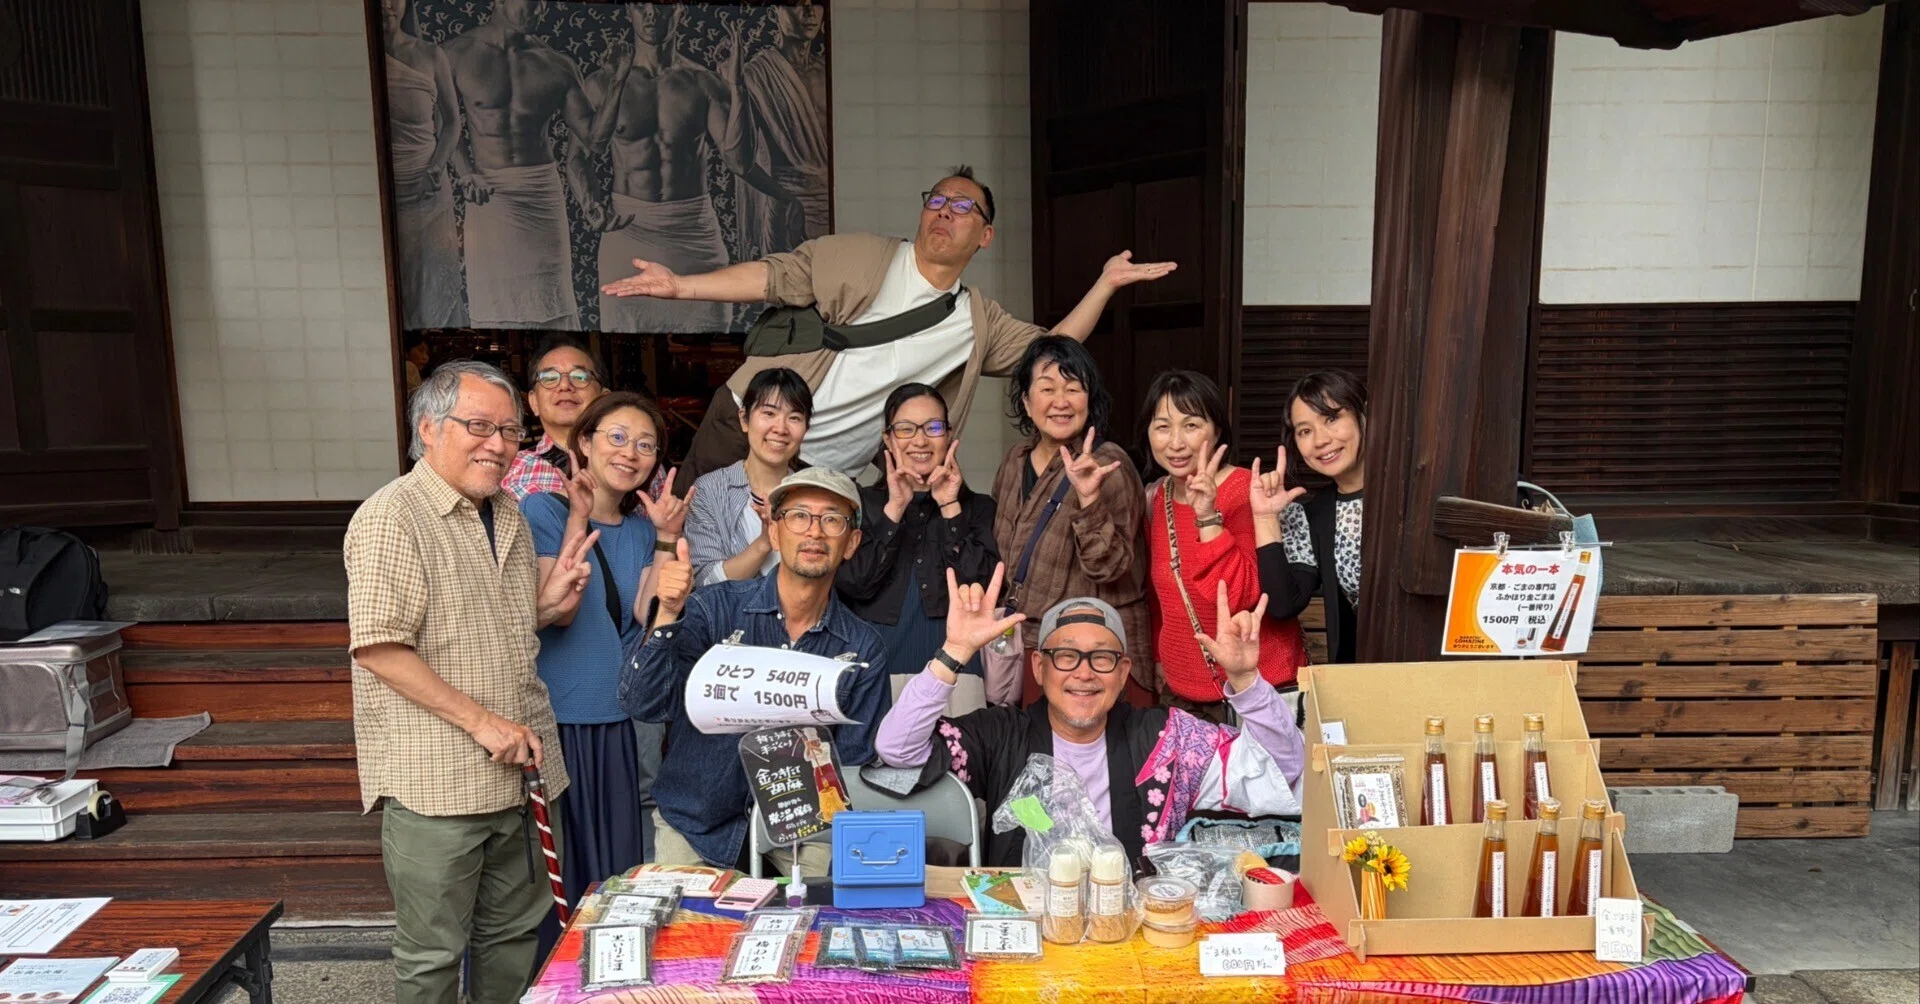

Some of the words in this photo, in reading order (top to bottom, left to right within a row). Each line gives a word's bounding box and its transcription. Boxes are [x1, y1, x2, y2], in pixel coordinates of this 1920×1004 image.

[1501, 563, 1560, 575] 本気の一本
[1490, 583, 1557, 591] 京都・ごまの専門店
[1496, 593, 1555, 601] ふかほり金ごま油
[1482, 615, 1519, 624] 1500円
[716, 663, 755, 680] ひとつ
[766, 669, 810, 687] 540円
[703, 684, 740, 702] 3個で
[753, 690, 808, 709] 1500円
[761, 740, 793, 755] 手づくり
[766, 778, 804, 796] 胡麻
